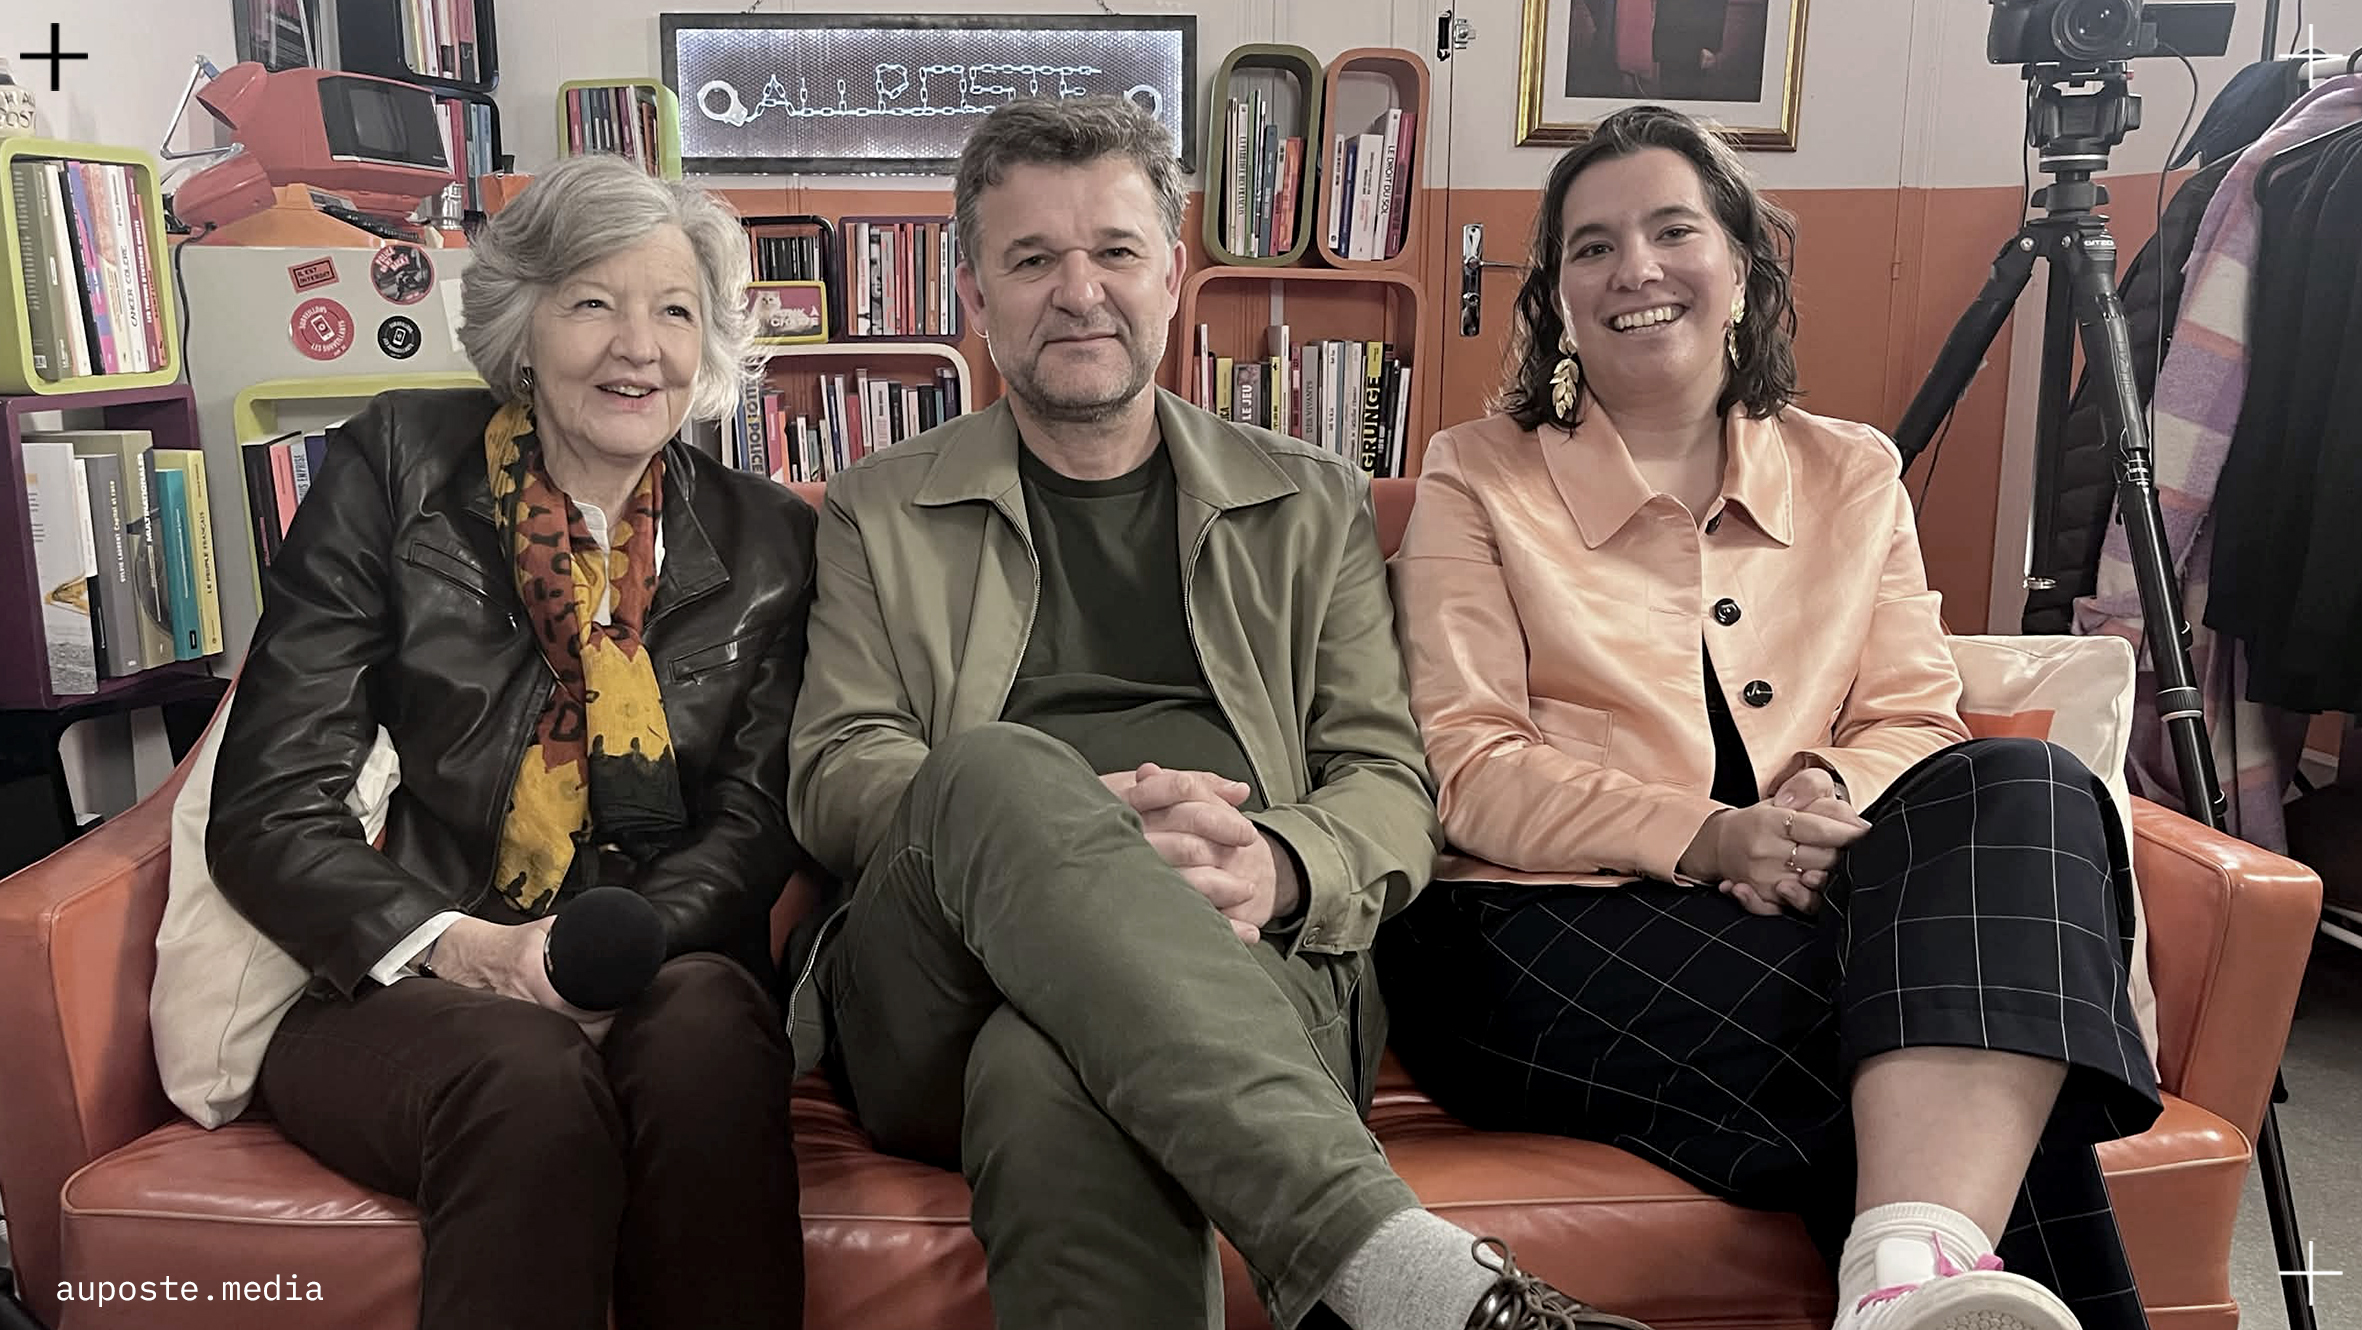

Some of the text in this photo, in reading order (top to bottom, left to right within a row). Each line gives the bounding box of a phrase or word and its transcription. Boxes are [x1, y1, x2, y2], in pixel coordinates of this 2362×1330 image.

[1380, 145, 1396, 215] LE DROIT DU SOL
[125, 288, 139, 327] CANCER
[1241, 384, 1253, 421] LE JEU
[1305, 380, 1313, 416] VIVANTS
[1362, 376, 1381, 472] GRUNGE
[293, 454, 308, 482] EMPRISE
[748, 422, 764, 474] POLICE
[137, 453, 153, 543] MULTINATIONALES
[199, 511, 213, 594] LE PEUPLE FRANÇAIS
